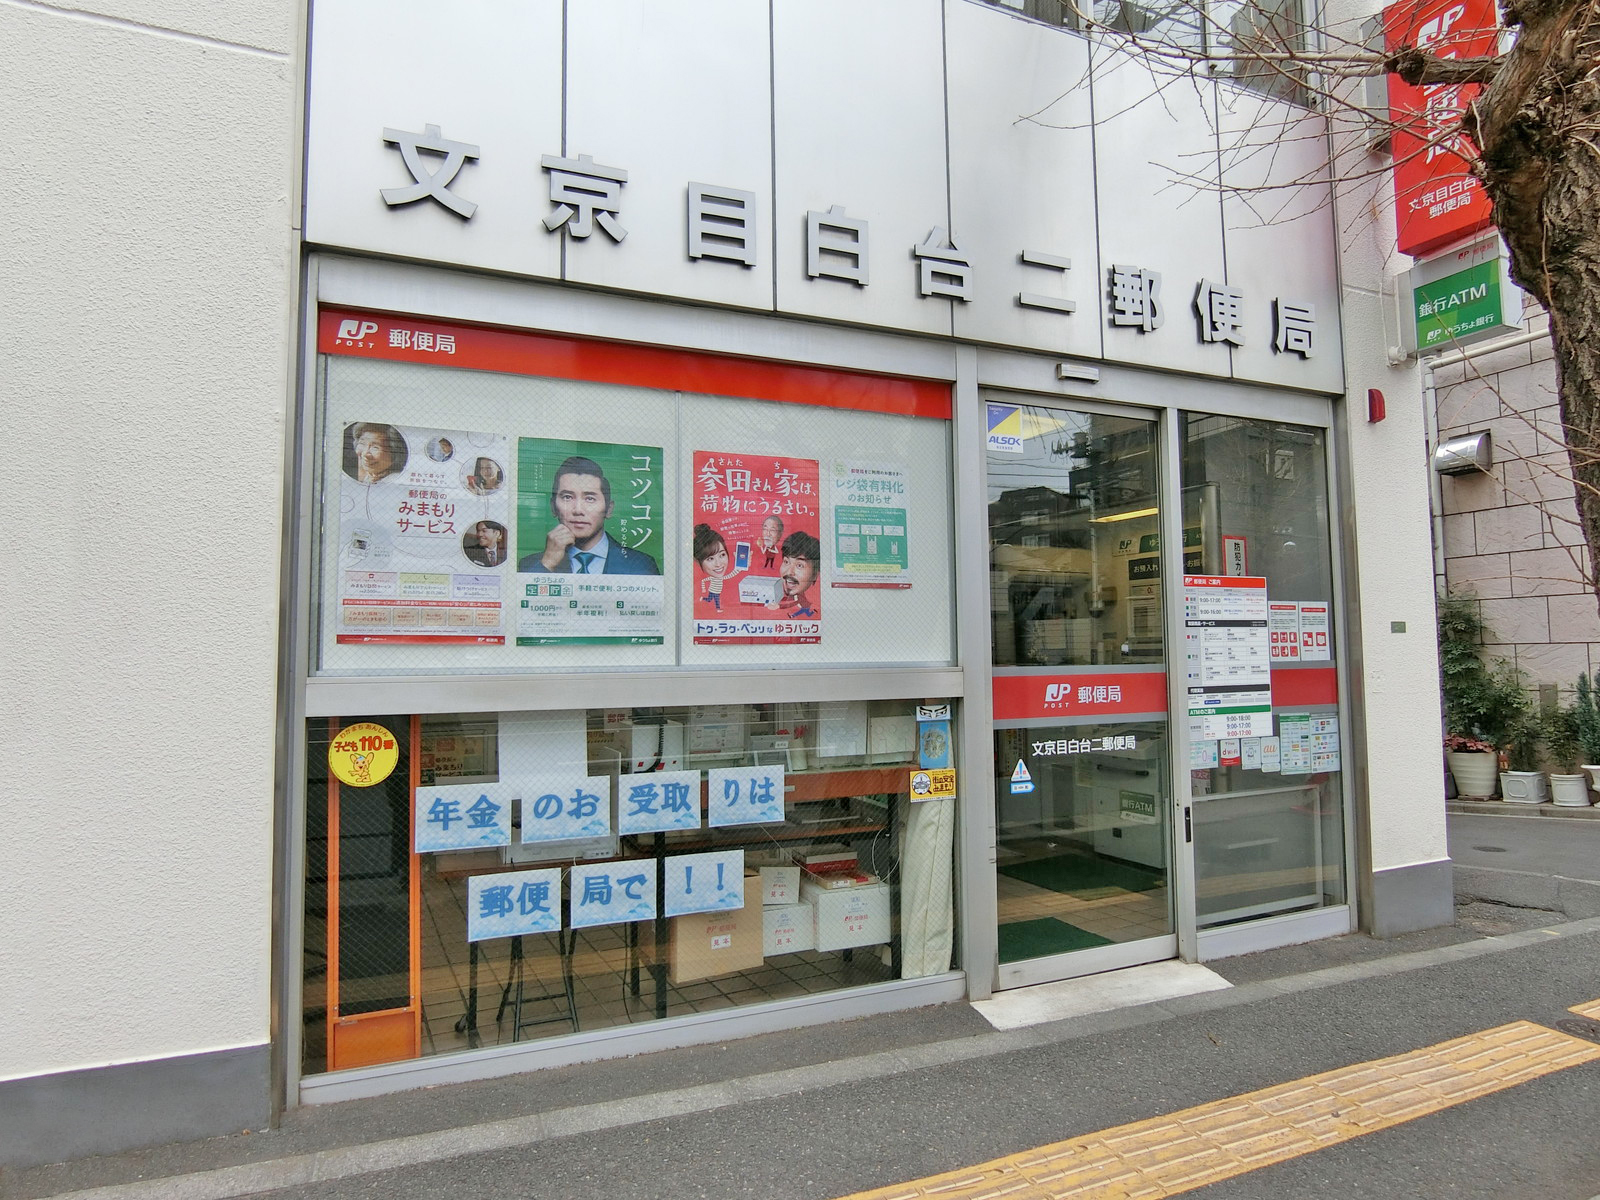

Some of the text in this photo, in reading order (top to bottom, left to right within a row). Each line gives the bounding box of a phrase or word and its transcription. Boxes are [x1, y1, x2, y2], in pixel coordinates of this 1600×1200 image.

[1429, 192, 1471, 219] 郵便局
[378, 122, 1318, 360] 文京目白台二郵便局
[1419, 283, 1487, 317] 銀行ATM
[1445, 313, 1495, 336] ゆうちょ銀行
[335, 339, 375, 349] POST
[388, 328, 456, 355] 郵便局
[988, 435, 1021, 446] ALSOK
[718, 457, 744, 467] さんた
[408, 489, 448, 500] 郵便局の
[835, 478, 905, 494] レジ袋有料化
[398, 501, 456, 518] みまもり
[630, 455, 653, 549] コツコツ
[699, 494, 815, 517] 荷物にうるさい。
[847, 493, 892, 505] のお知らせ
[396, 518, 457, 535] サービス
[1077, 685, 1121, 704] 郵便局
[1032, 735, 1136, 757] 文京目白台二郵便局
[426, 775, 775, 831] 年金 のお 受取 りは
[479, 881, 551, 919] 郵便
[580, 873, 648, 907] 局で
